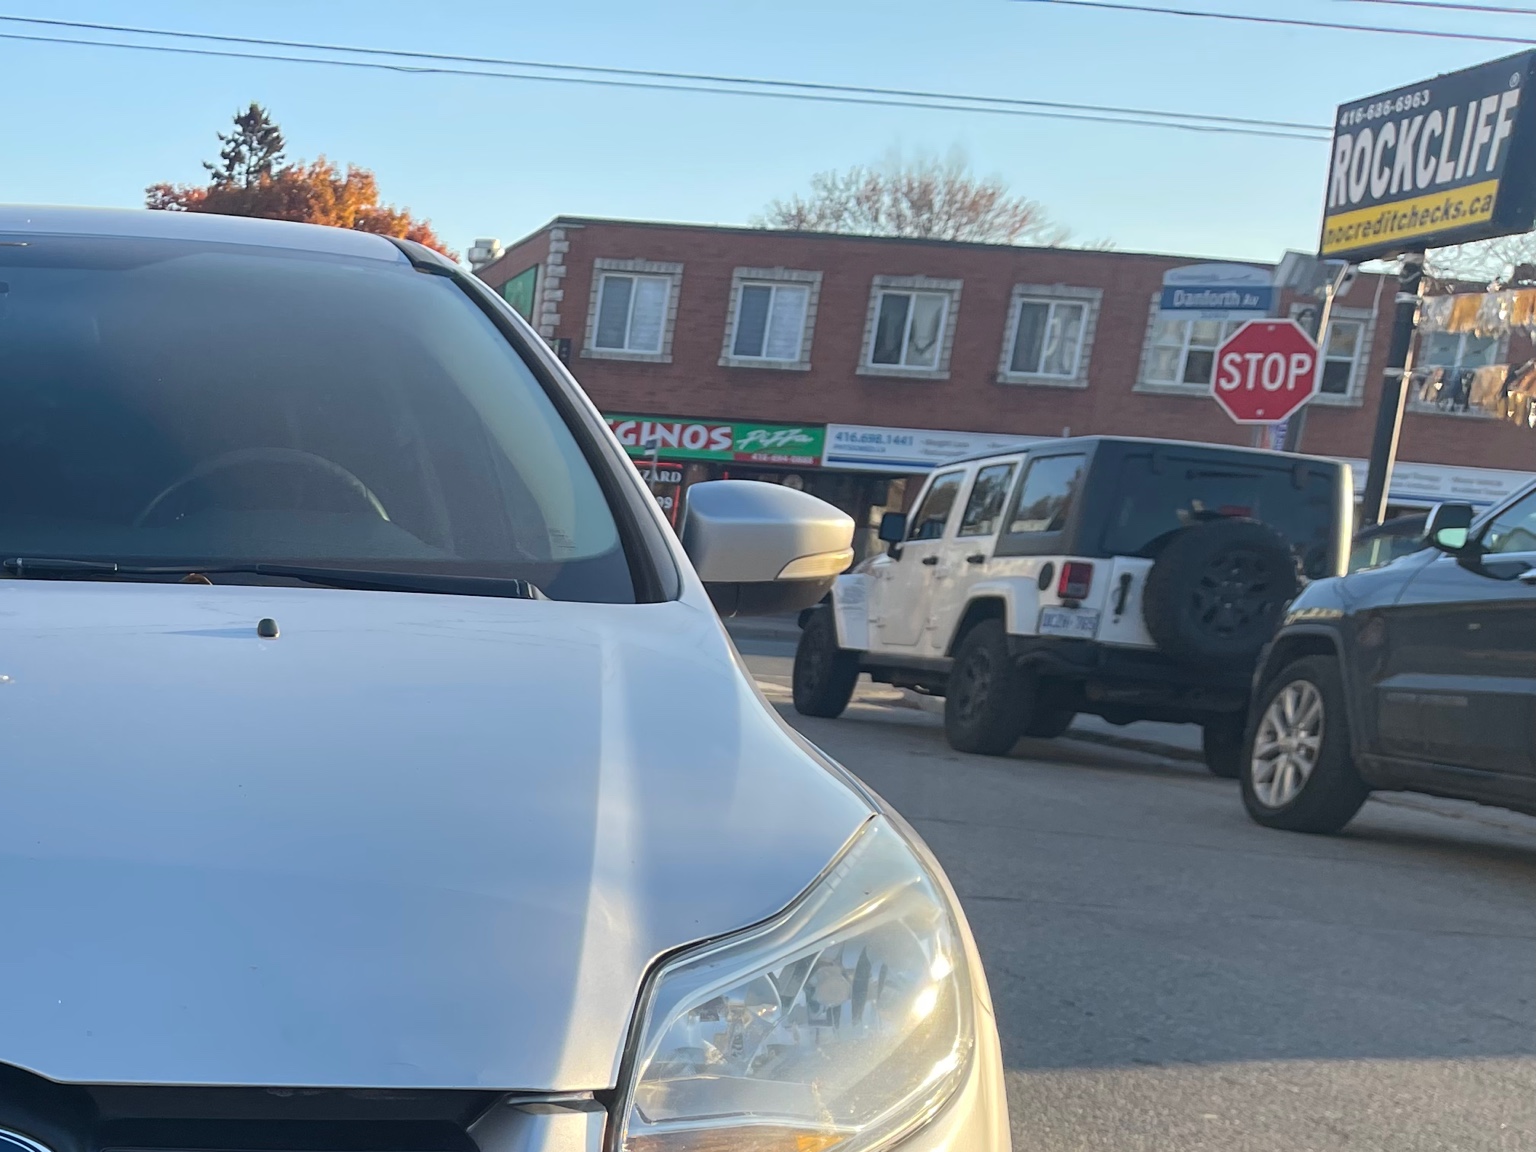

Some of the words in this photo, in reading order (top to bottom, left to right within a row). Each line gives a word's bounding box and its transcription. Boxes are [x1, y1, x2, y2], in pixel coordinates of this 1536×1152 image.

[1329, 87, 1521, 208] ROCKCLIFF
[1325, 193, 1493, 245] nocreditchecks.ca
[1173, 289, 1240, 307] Danforth
[1219, 352, 1312, 391] STOP
[609, 418, 732, 451] GINOS
[640, 469, 682, 483] ZARD
